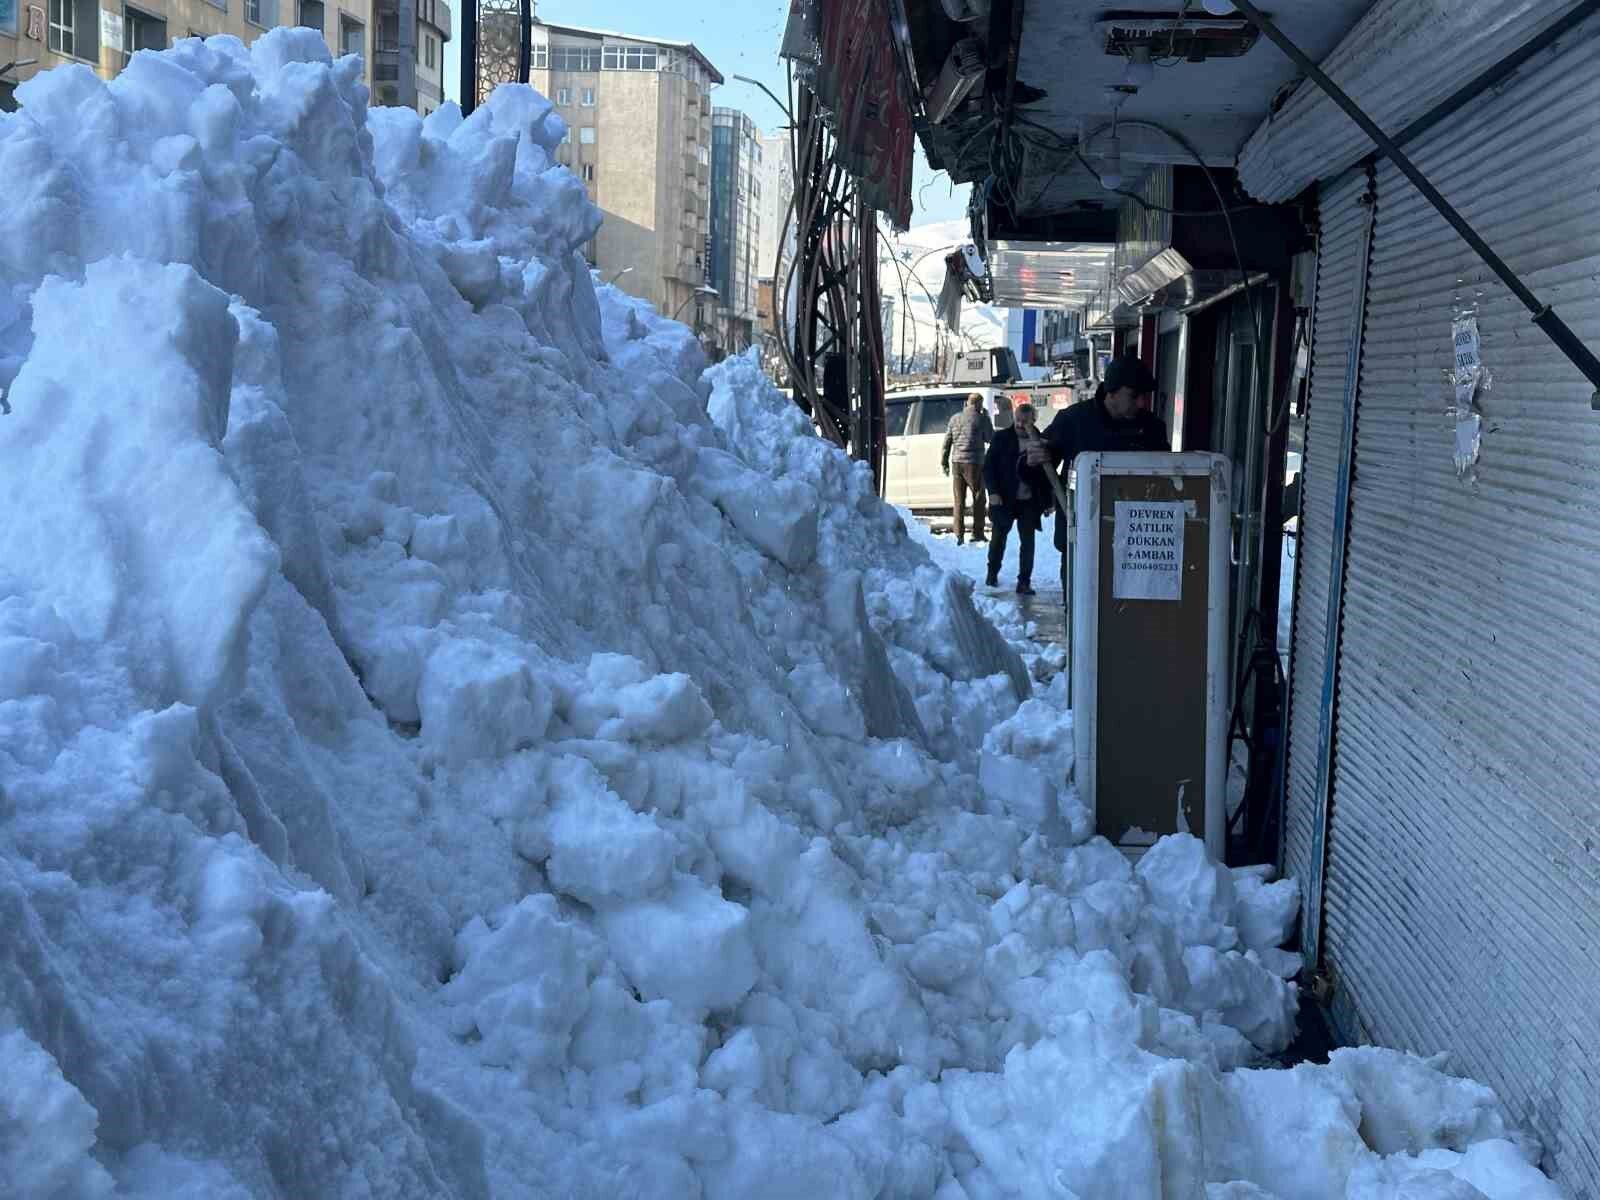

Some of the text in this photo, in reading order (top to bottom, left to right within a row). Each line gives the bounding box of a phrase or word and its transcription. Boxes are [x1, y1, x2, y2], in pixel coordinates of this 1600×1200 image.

[1129, 509, 1175, 521] DEVREN
[1129, 523, 1174, 533] SATILIK
[1128, 550, 1175, 561] +AMBAR
